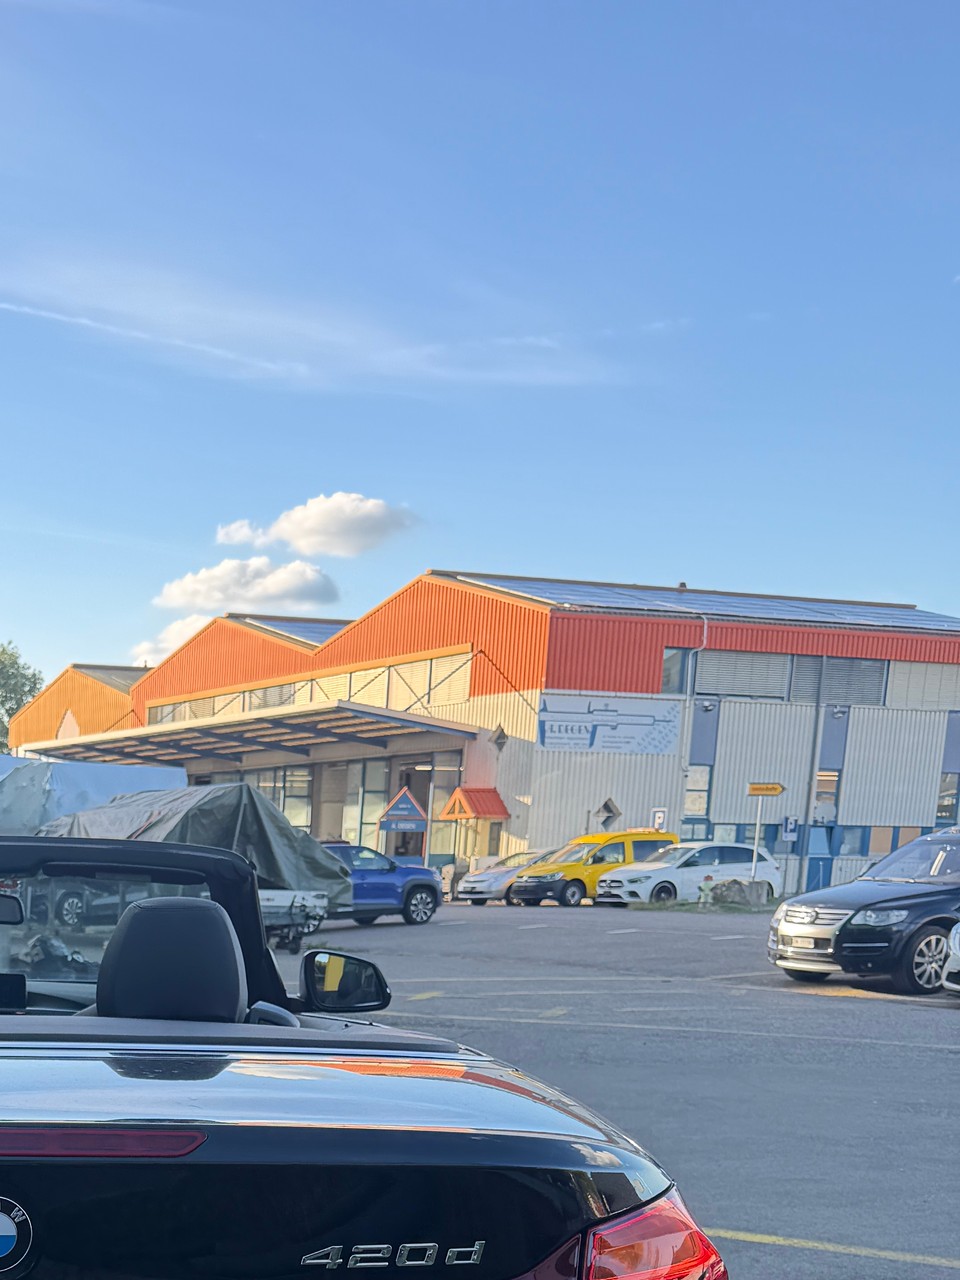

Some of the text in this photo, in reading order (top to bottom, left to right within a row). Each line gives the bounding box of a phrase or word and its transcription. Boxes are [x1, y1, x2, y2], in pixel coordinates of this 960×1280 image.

[655, 811, 665, 829] P
[787, 819, 796, 833] P
[301, 1240, 486, 1269] 420d
